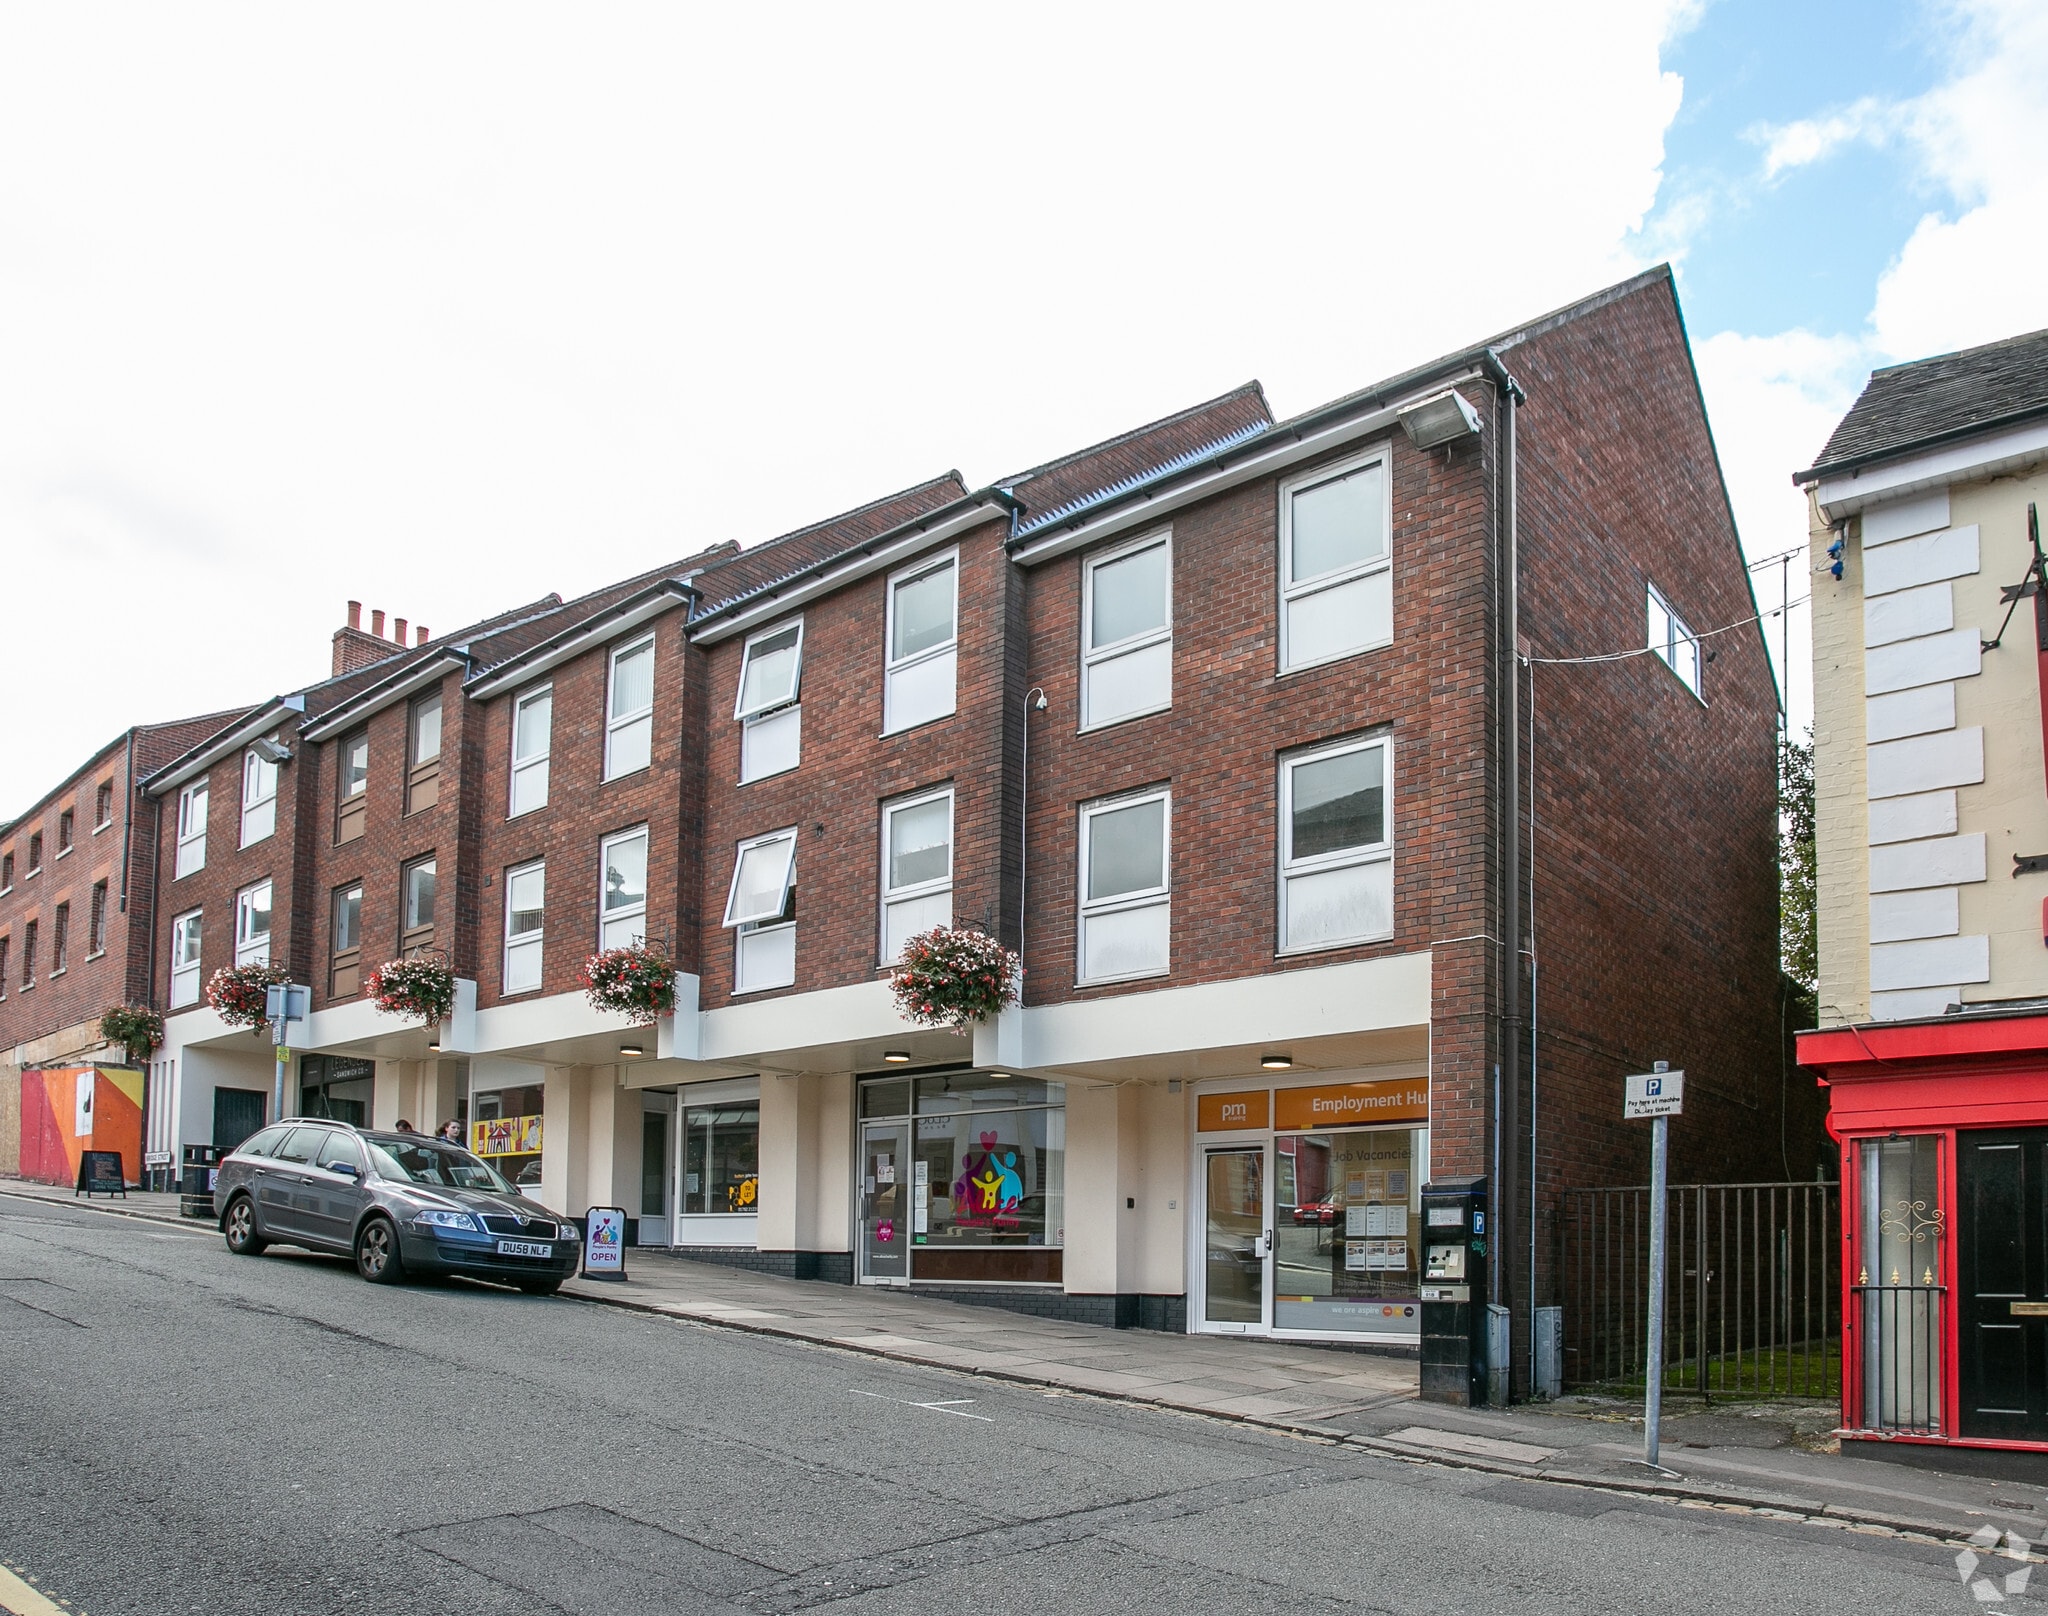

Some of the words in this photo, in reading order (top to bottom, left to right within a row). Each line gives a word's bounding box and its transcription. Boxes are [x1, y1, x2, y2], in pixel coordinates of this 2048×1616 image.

[1649, 1080, 1659, 1095] P
[1312, 1093, 1402, 1114] Employment
[1406, 1091, 1428, 1106] Hu
[1222, 1103, 1246, 1121] pm
[1334, 1151, 1353, 1162] Job
[1357, 1148, 1415, 1160] Vacancies
[956, 1187, 1019, 1214] Alice
[503, 1242, 529, 1254] DU58
[530, 1245, 548, 1256] NLF
[592, 1252, 616, 1260] OPEN
[1358, 1306, 1379, 1315] aspire
